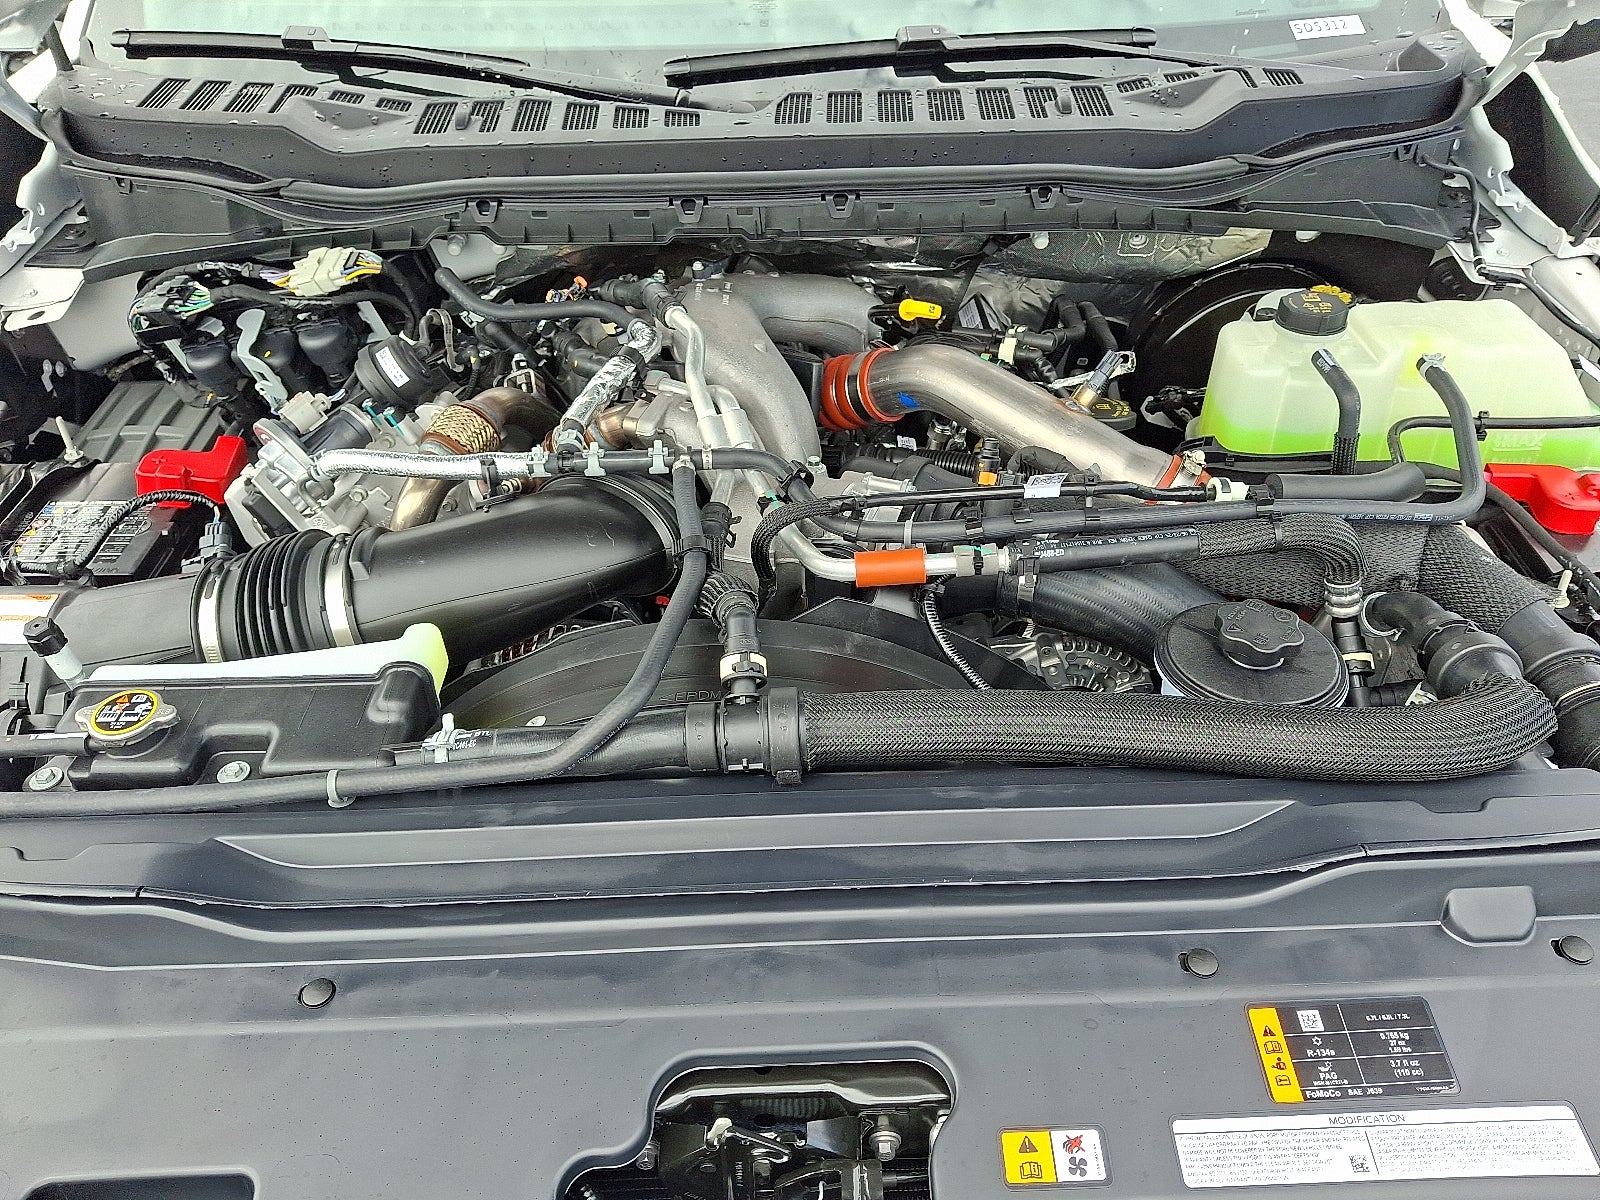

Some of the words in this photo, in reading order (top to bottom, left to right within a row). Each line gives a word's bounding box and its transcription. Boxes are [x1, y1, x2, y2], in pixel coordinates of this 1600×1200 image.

[1400, 1032, 1409, 1040] kg
[1306, 1048, 1336, 1057] R-134a
[1390, 1060, 1401, 1068] 3.7
[1319, 1072, 1338, 1080] PAG
[1394, 1069, 1410, 1078] (110
[1412, 1068, 1424, 1076] cc)
[1306, 1089, 1341, 1098] FoMoCo
[1328, 1114, 1406, 1124] MODIFICATION
